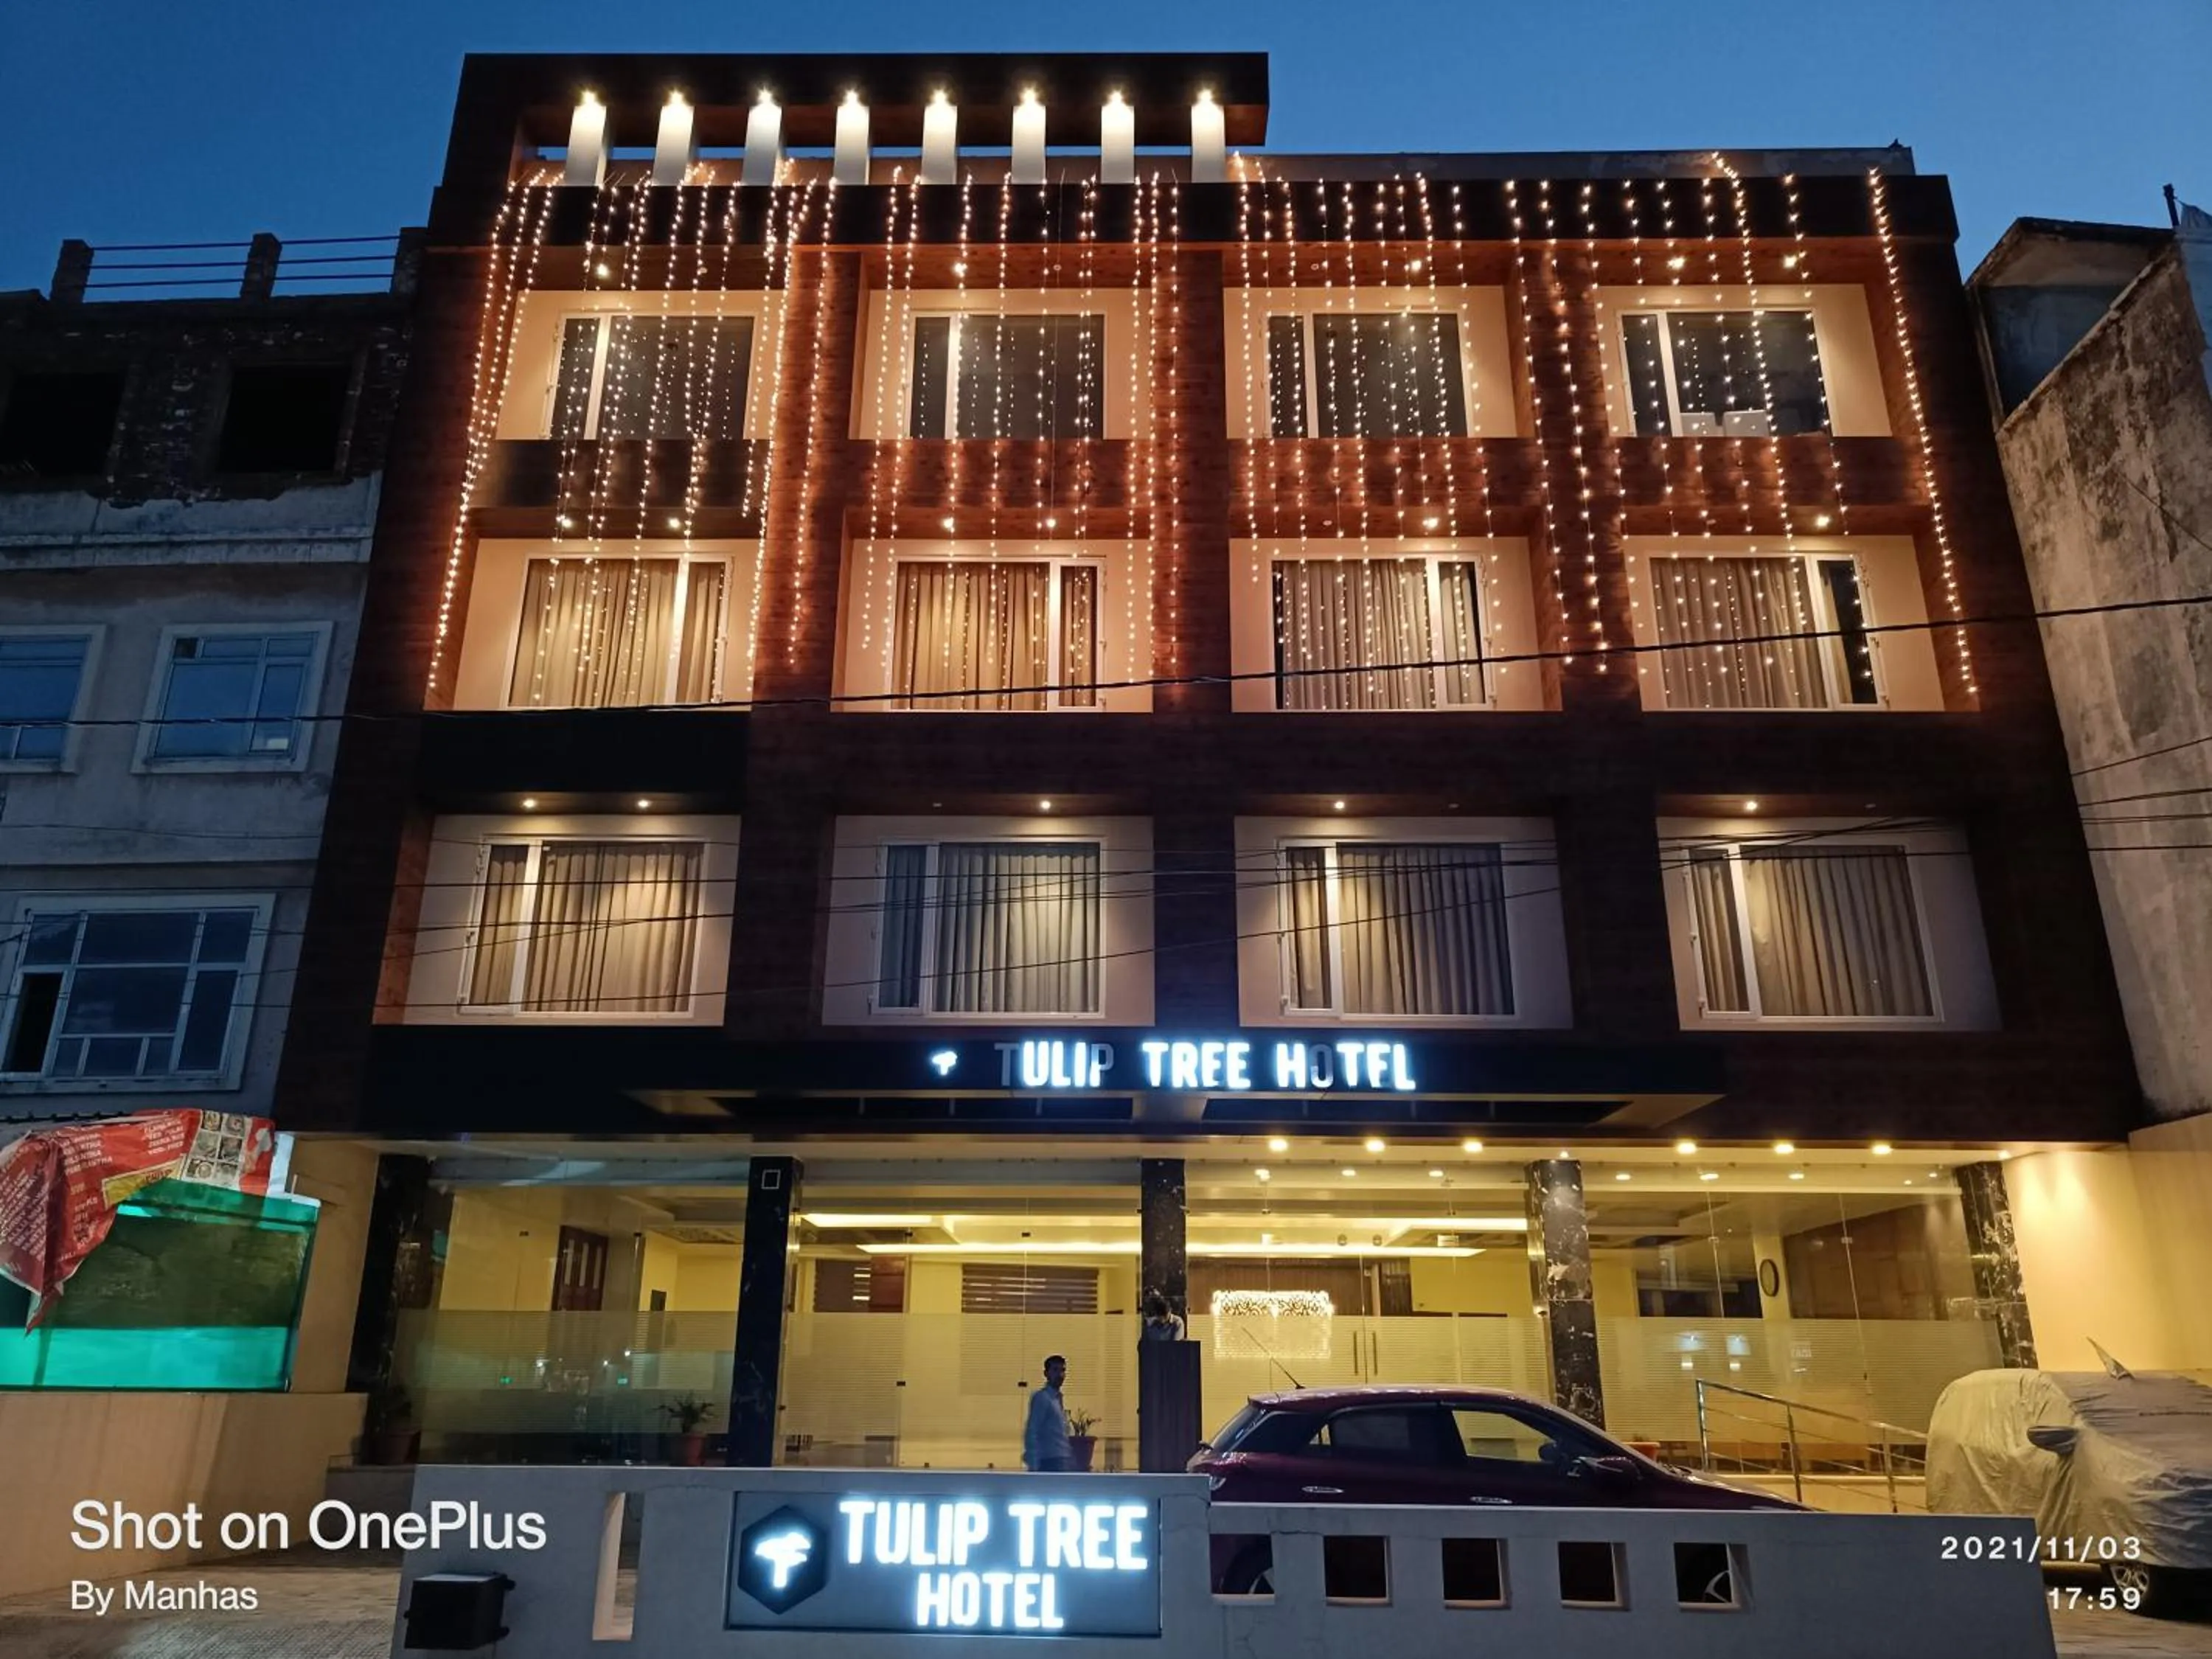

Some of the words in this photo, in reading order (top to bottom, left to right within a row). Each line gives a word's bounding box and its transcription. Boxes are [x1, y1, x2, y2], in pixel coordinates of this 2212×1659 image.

[993, 1040, 1114, 1087] TULIP
[1142, 1042, 1251, 1088] TREE
[1276, 1043, 1416, 1090] HOTEL
[839, 1500, 990, 1565] TULIP
[1008, 1504, 1148, 1569] TREE
[917, 1573, 1064, 1629] HOTEL
